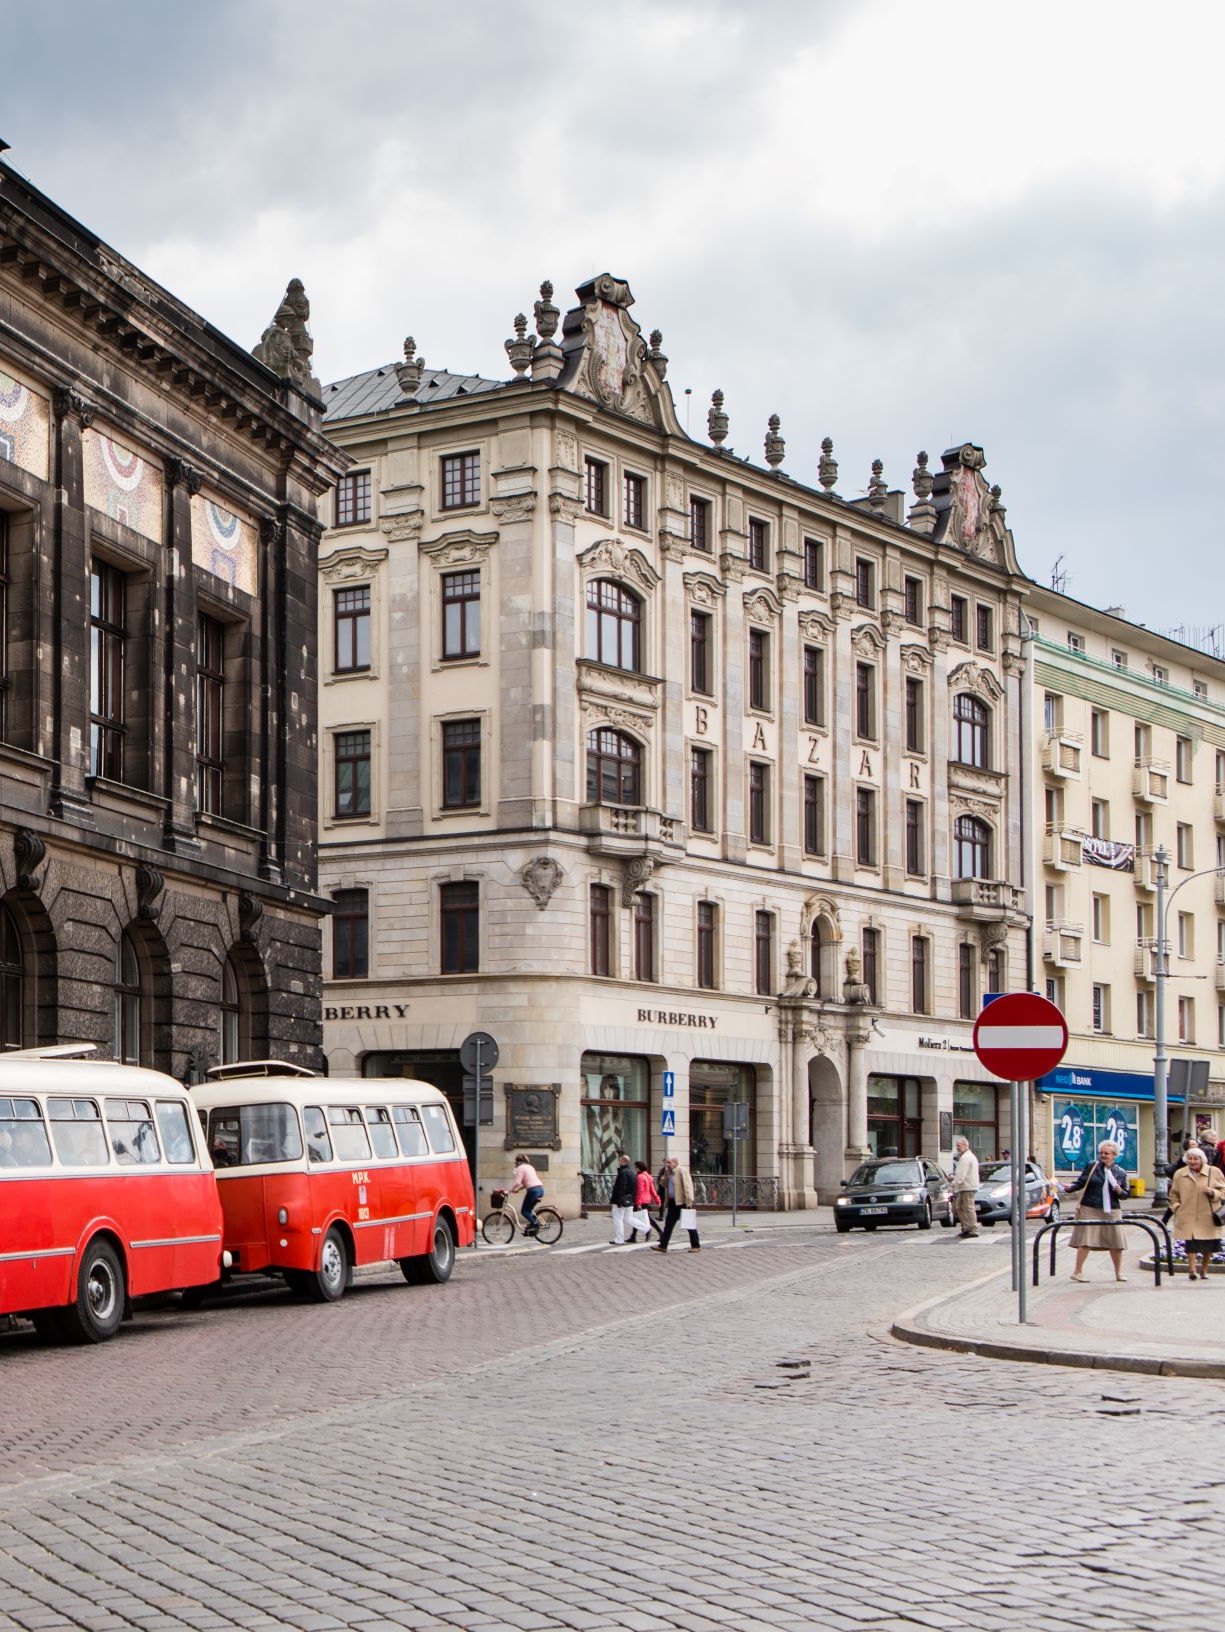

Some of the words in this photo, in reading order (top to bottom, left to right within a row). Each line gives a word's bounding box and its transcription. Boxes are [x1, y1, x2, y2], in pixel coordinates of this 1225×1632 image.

[695, 705, 920, 789] BAZAR
[637, 1008, 719, 1029] BURBERRY
[919, 1037, 942, 1049] Moliera
[942, 1039, 947, 1050] 2
[1076, 1076, 1092, 1087] BANK
